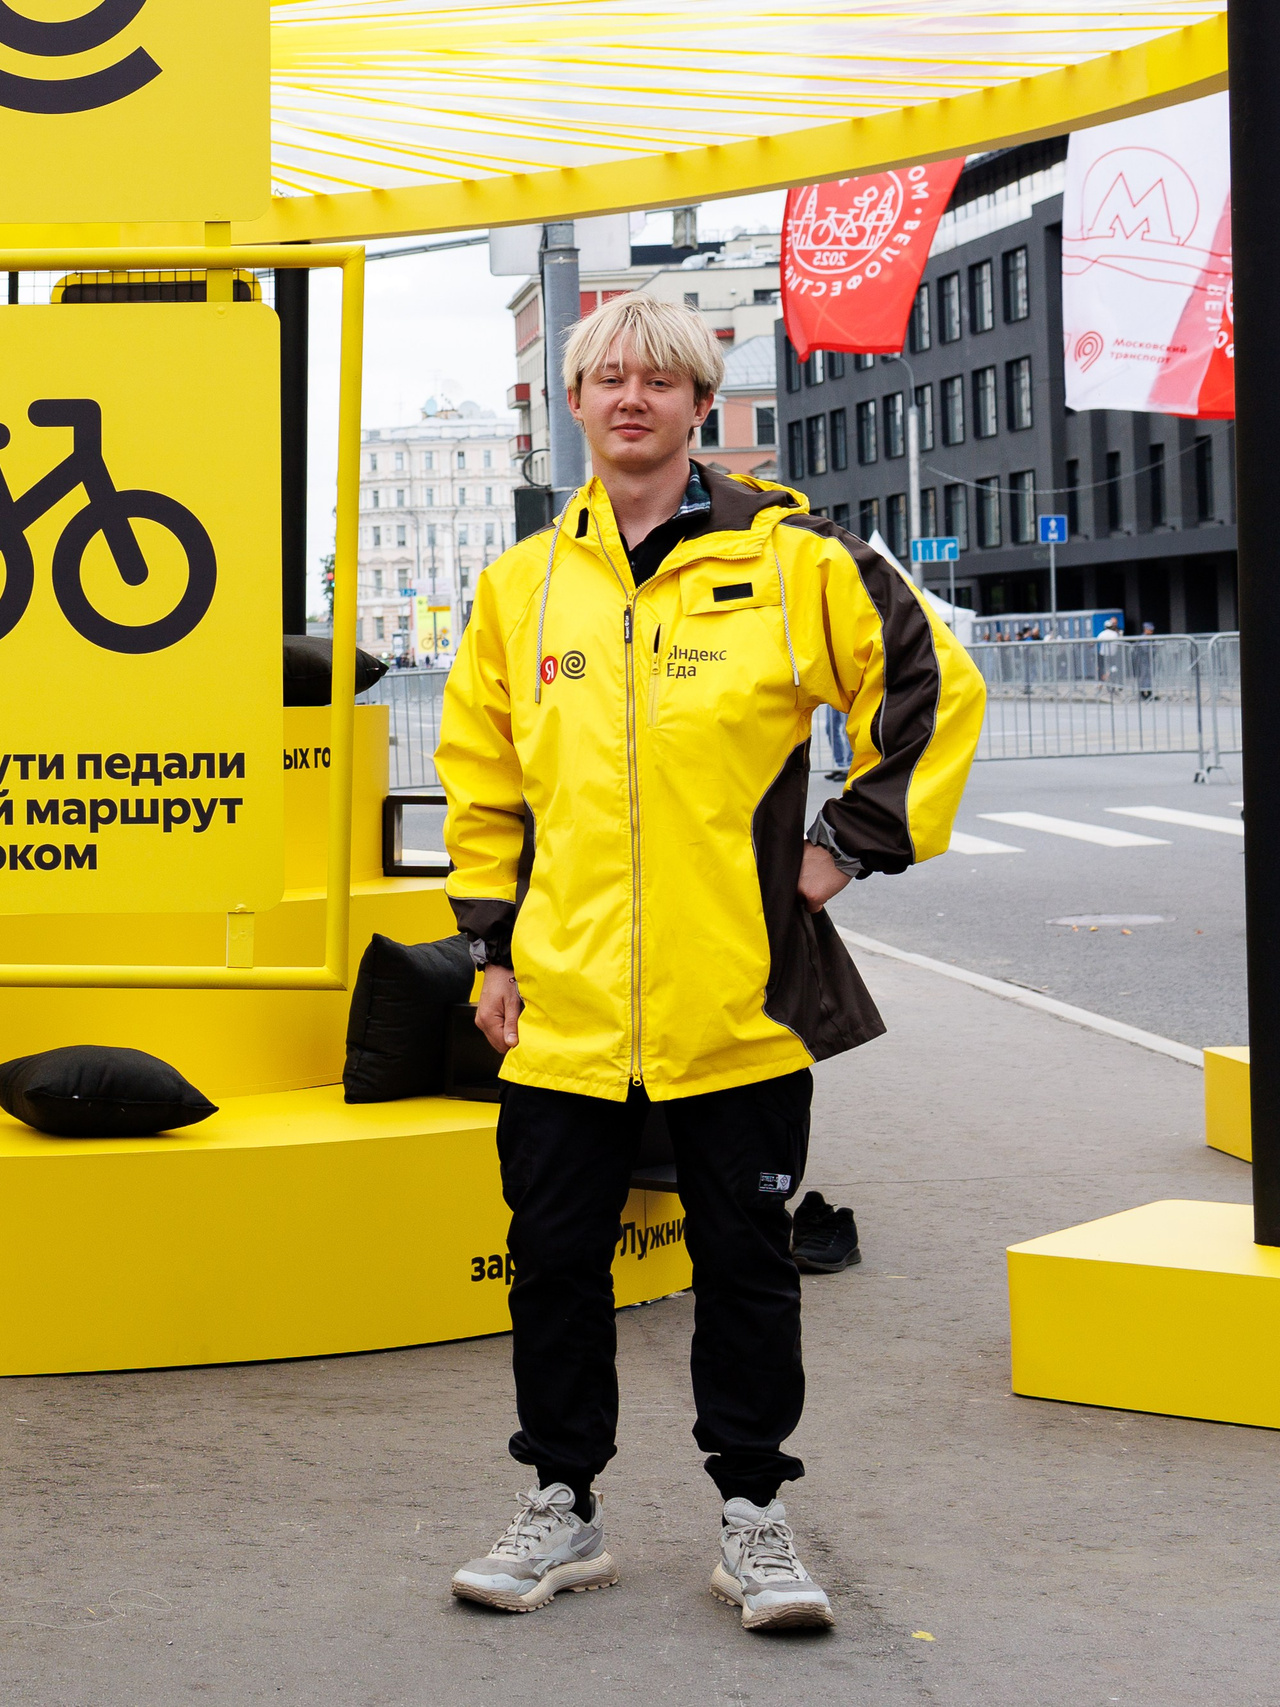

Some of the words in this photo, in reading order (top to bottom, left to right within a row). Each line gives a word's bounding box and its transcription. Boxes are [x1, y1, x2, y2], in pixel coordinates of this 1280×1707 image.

[1114, 338, 1188, 353] Московский
[1110, 351, 1172, 364] транспорт
[667, 645, 727, 662] Яндекс
[666, 662, 697, 678] Еда
[77, 752, 246, 787] педали
[26, 797, 244, 834] маршрут
